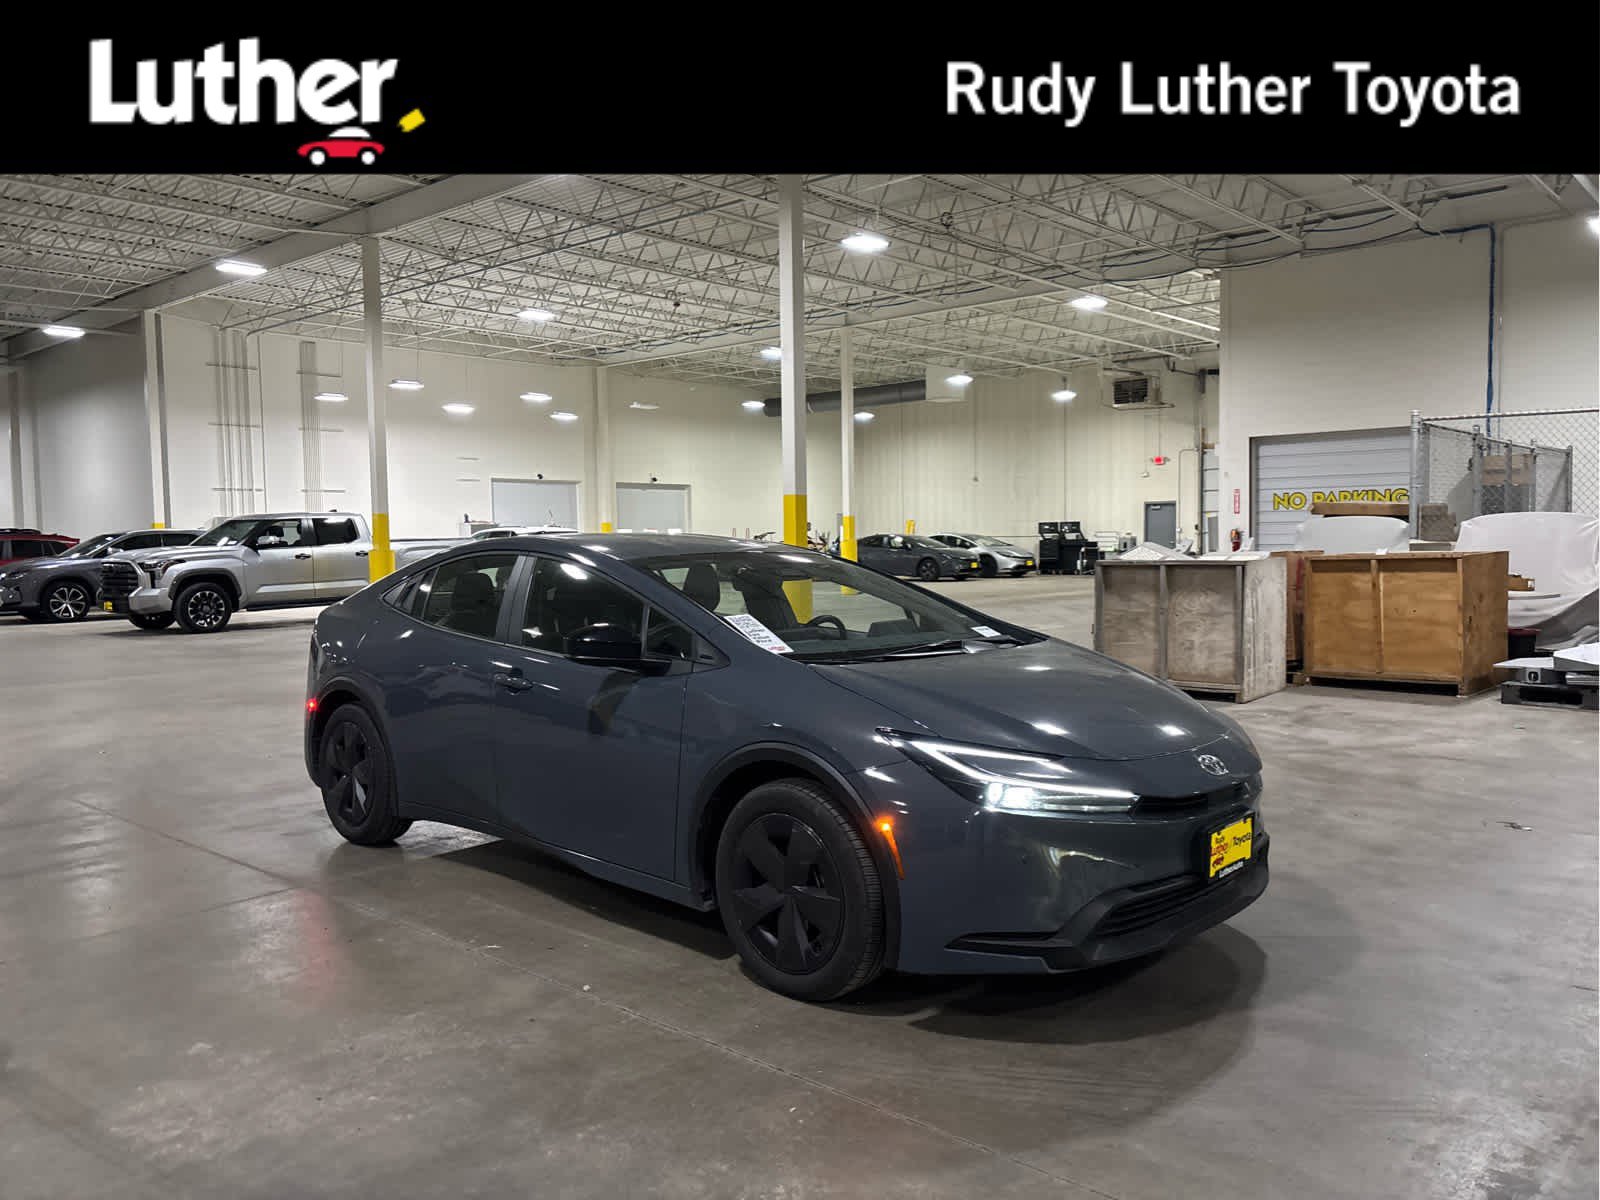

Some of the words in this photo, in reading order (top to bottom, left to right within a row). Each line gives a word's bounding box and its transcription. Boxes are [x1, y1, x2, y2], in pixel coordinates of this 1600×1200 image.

[1273, 492, 1307, 510] NO
[1311, 488, 1409, 504] PARKING
[1233, 832, 1252, 847] Toyota
